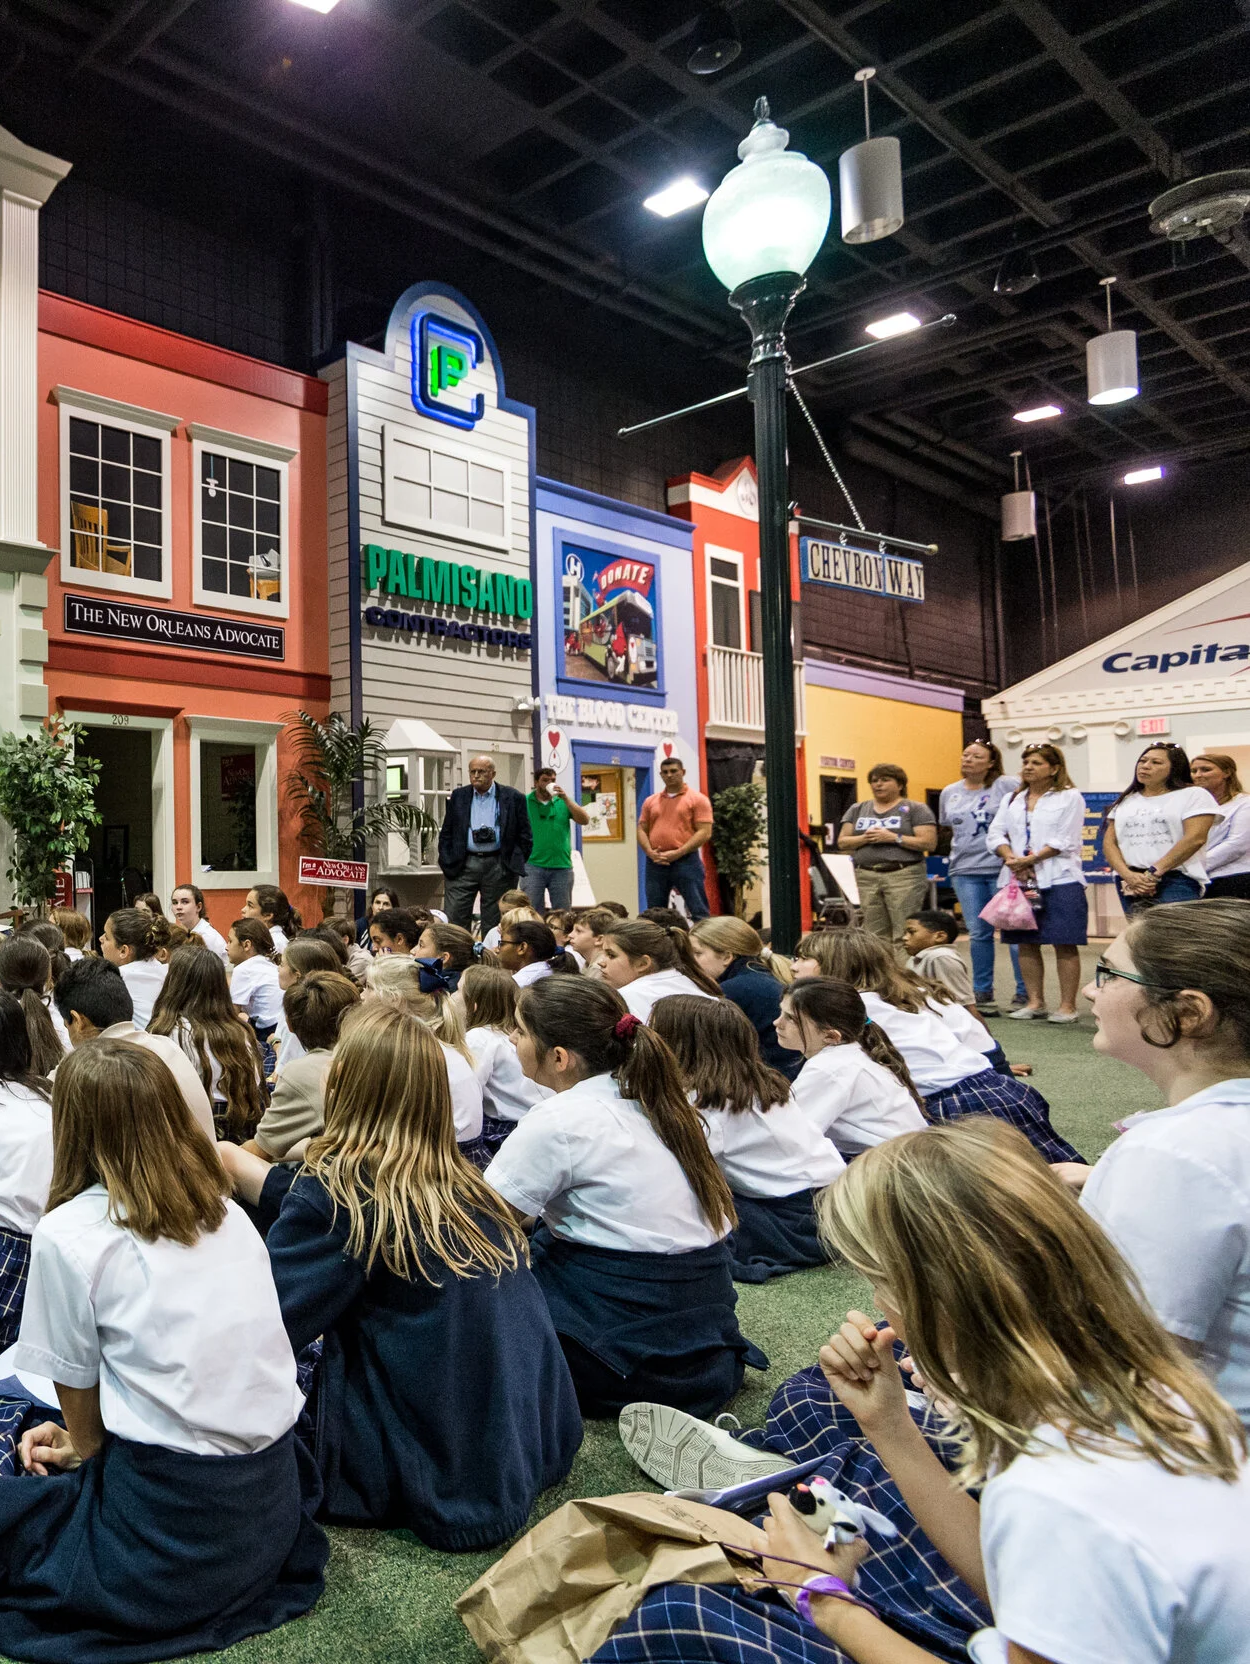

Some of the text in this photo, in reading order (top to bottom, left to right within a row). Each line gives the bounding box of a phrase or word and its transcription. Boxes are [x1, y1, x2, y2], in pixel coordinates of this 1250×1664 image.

[363, 543, 533, 619] PALMISANO
[601, 563, 650, 590] DONATE
[810, 543, 924, 598] CHEVRON WAY
[365, 606, 532, 649] CONTRACTORS
[112, 715, 130, 726] 209
[544, 694, 576, 721] THE
[577, 698, 626, 728] BLOOD
[1141, 718, 1165, 734] EXIT
[316, 866, 366, 880] ADVOCATE
